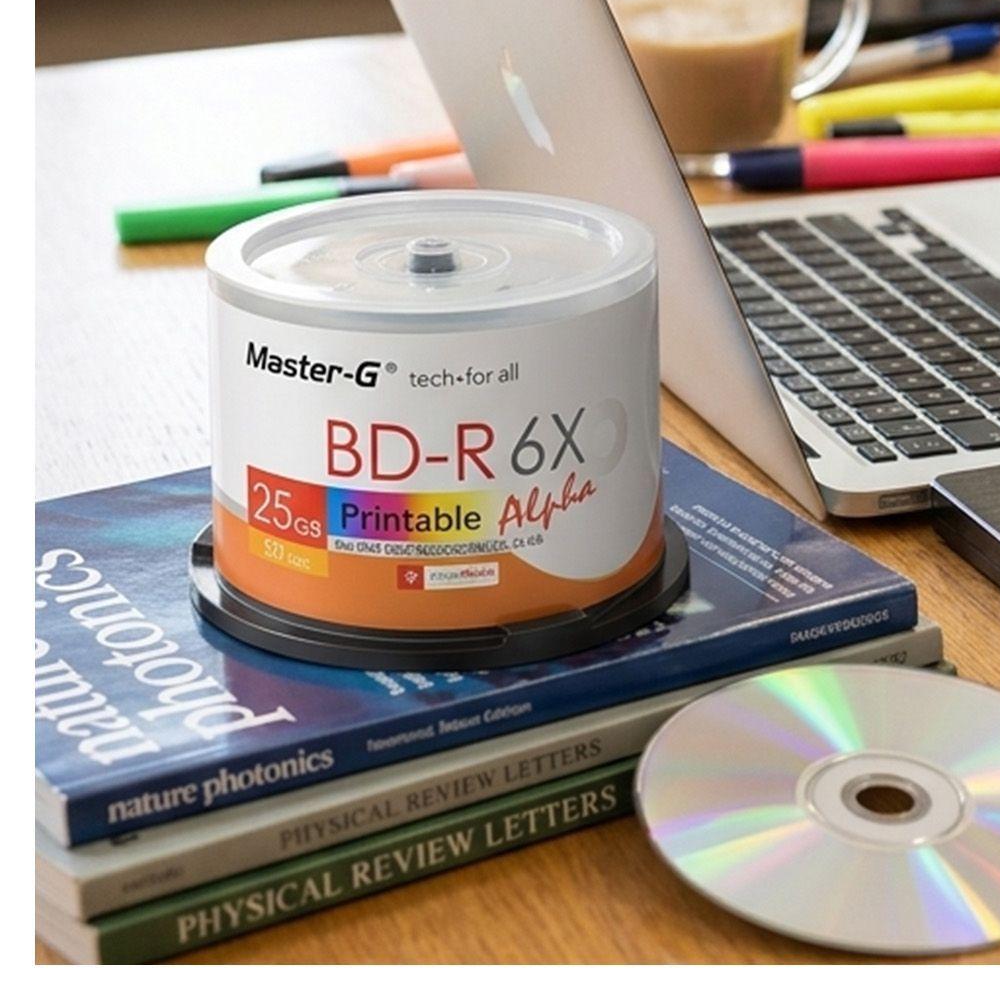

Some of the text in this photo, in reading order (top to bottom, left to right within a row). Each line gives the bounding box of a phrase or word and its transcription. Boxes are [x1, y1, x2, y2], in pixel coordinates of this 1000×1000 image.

[498, 361, 520, 384] all
[326, 406, 586, 482] BD-R 6X
[341, 502, 482, 532] Printable
[498, 471, 597, 536] Alpha
[35, 547, 298, 741] photonics
[107, 748, 335, 824] nature photonics
[280, 737, 603, 850] PHYSICAL REVIEW LETTERS
[176, 871, 343, 944] PHYSICAL
[350, 827, 476, 890] REVIEW
[485, 783, 618, 848] LETTERS
